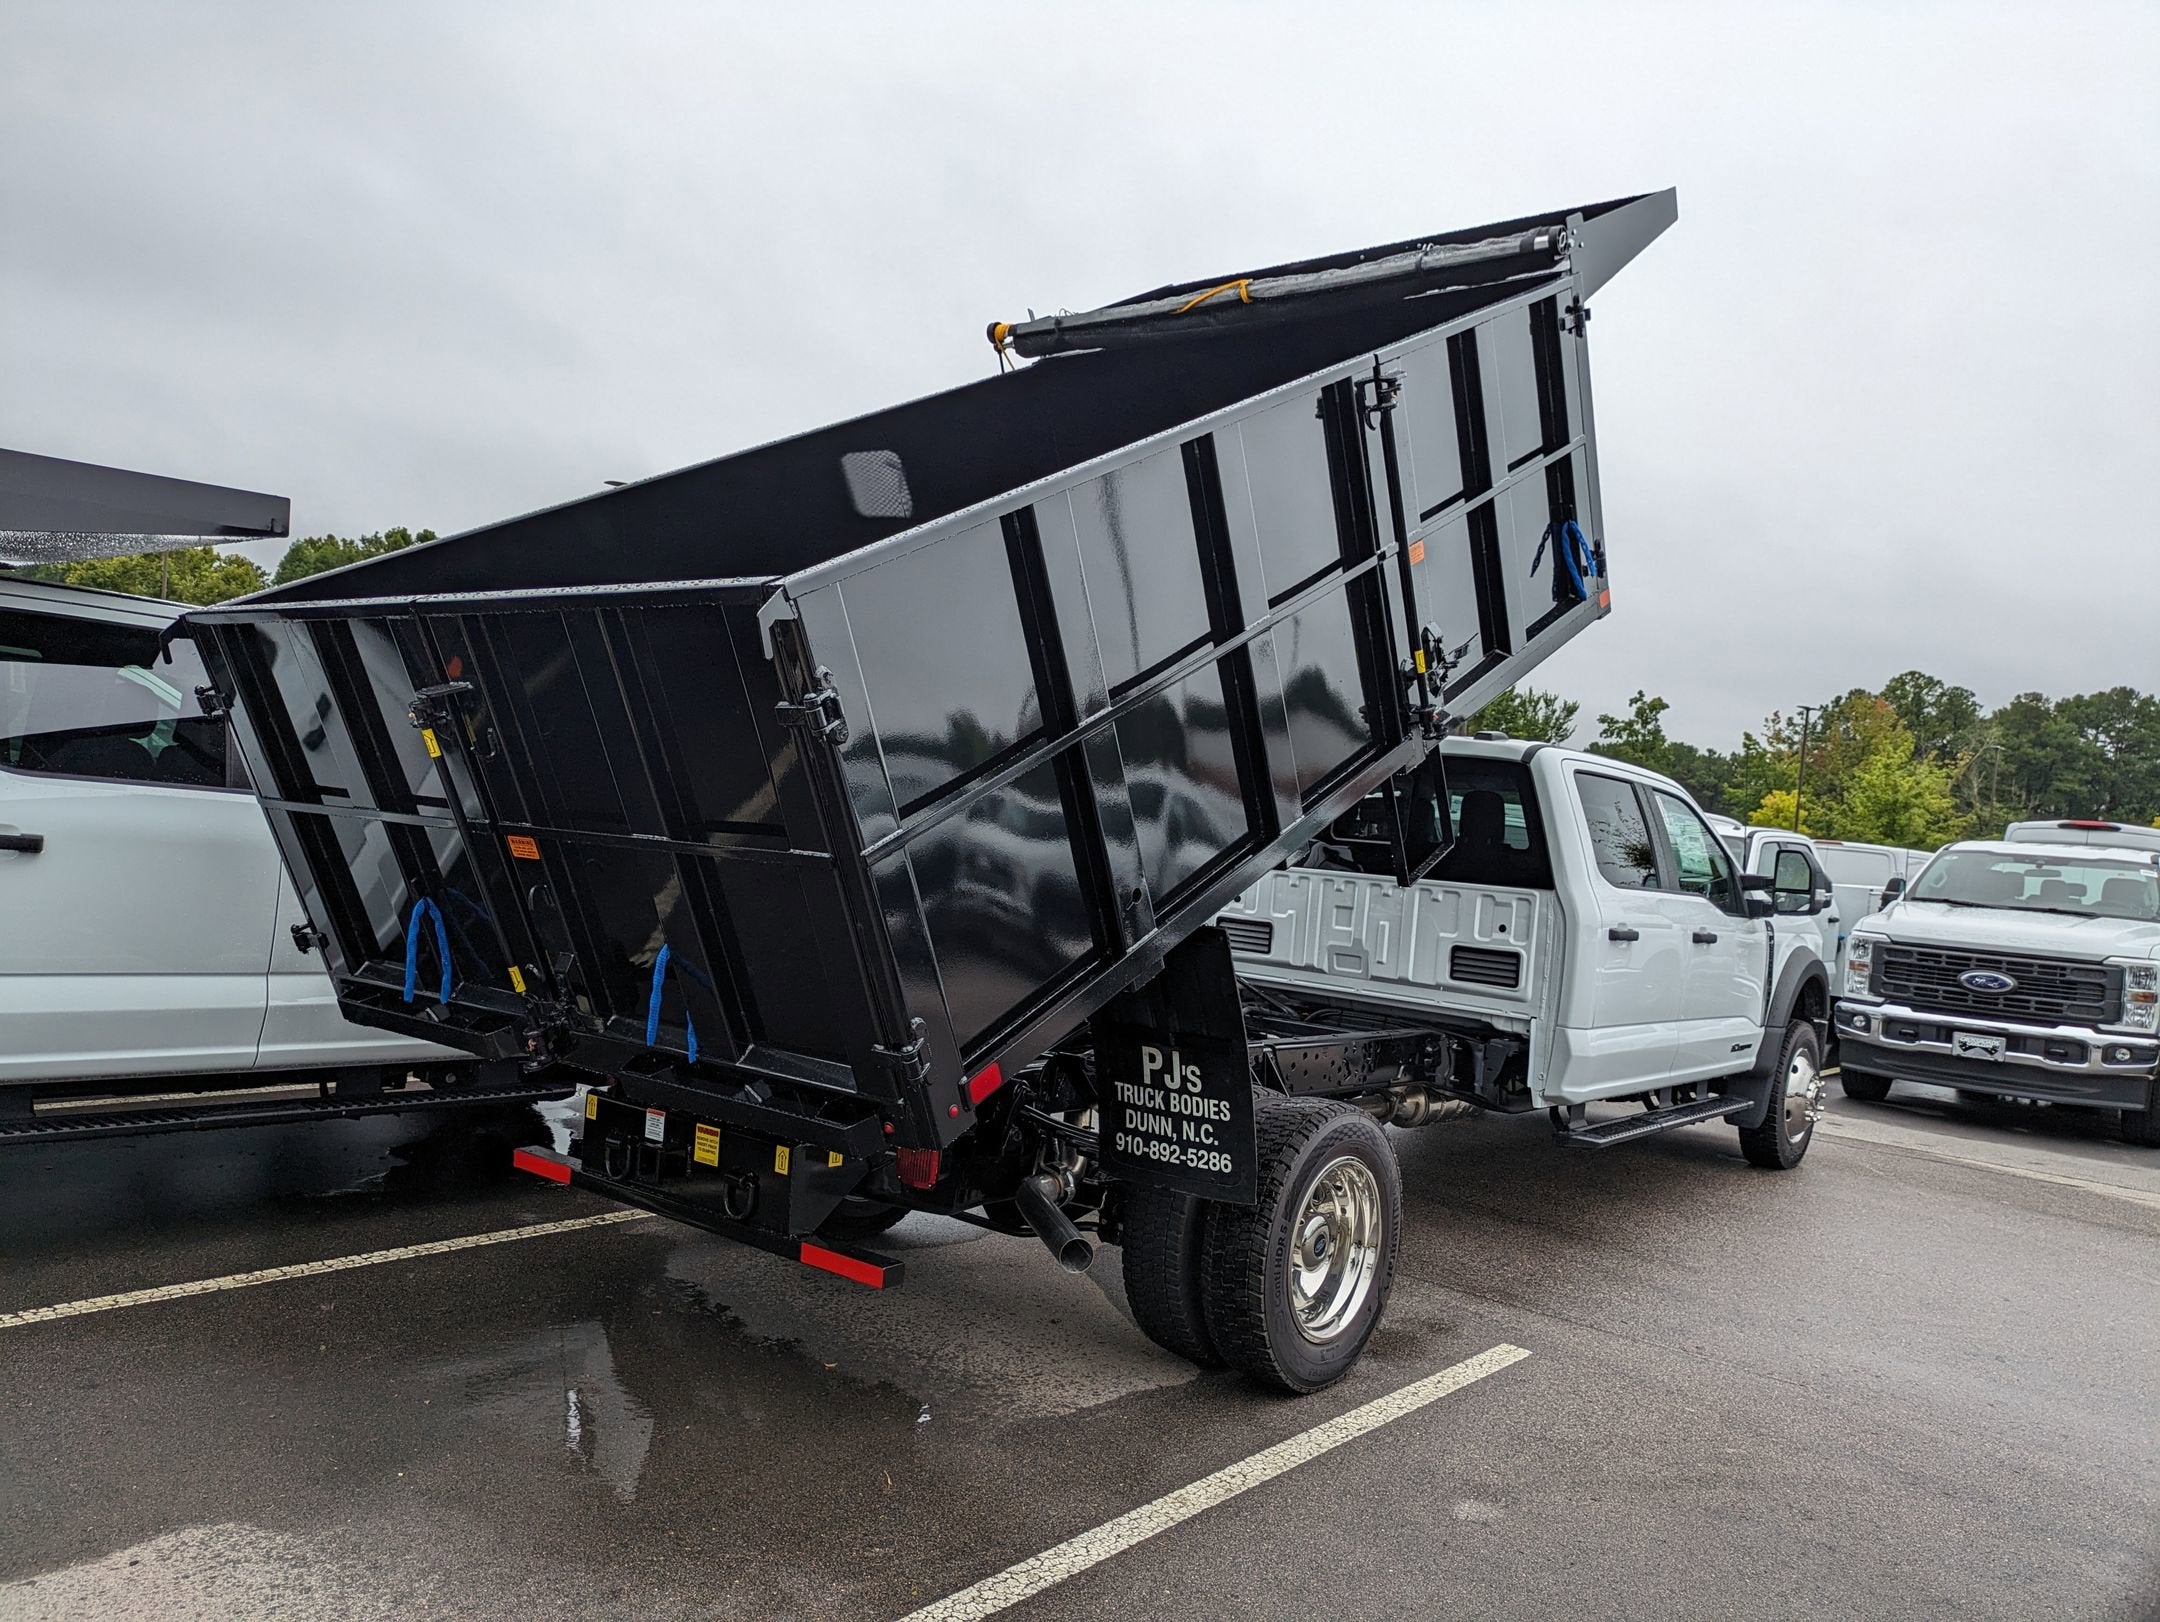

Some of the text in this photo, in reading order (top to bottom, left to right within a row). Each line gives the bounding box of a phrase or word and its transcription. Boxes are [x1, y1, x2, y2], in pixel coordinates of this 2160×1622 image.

[1142, 1045, 1202, 1093] PJ's
[1114, 1081, 1231, 1121] TRUCK BODIES
[1125, 1108, 1219, 1146] DUNN, N.C.
[1116, 1132, 1232, 1173] 910-892-5286
[1274, 1237, 1286, 1269] HDR
[1274, 1271, 1282, 1308] Conti
